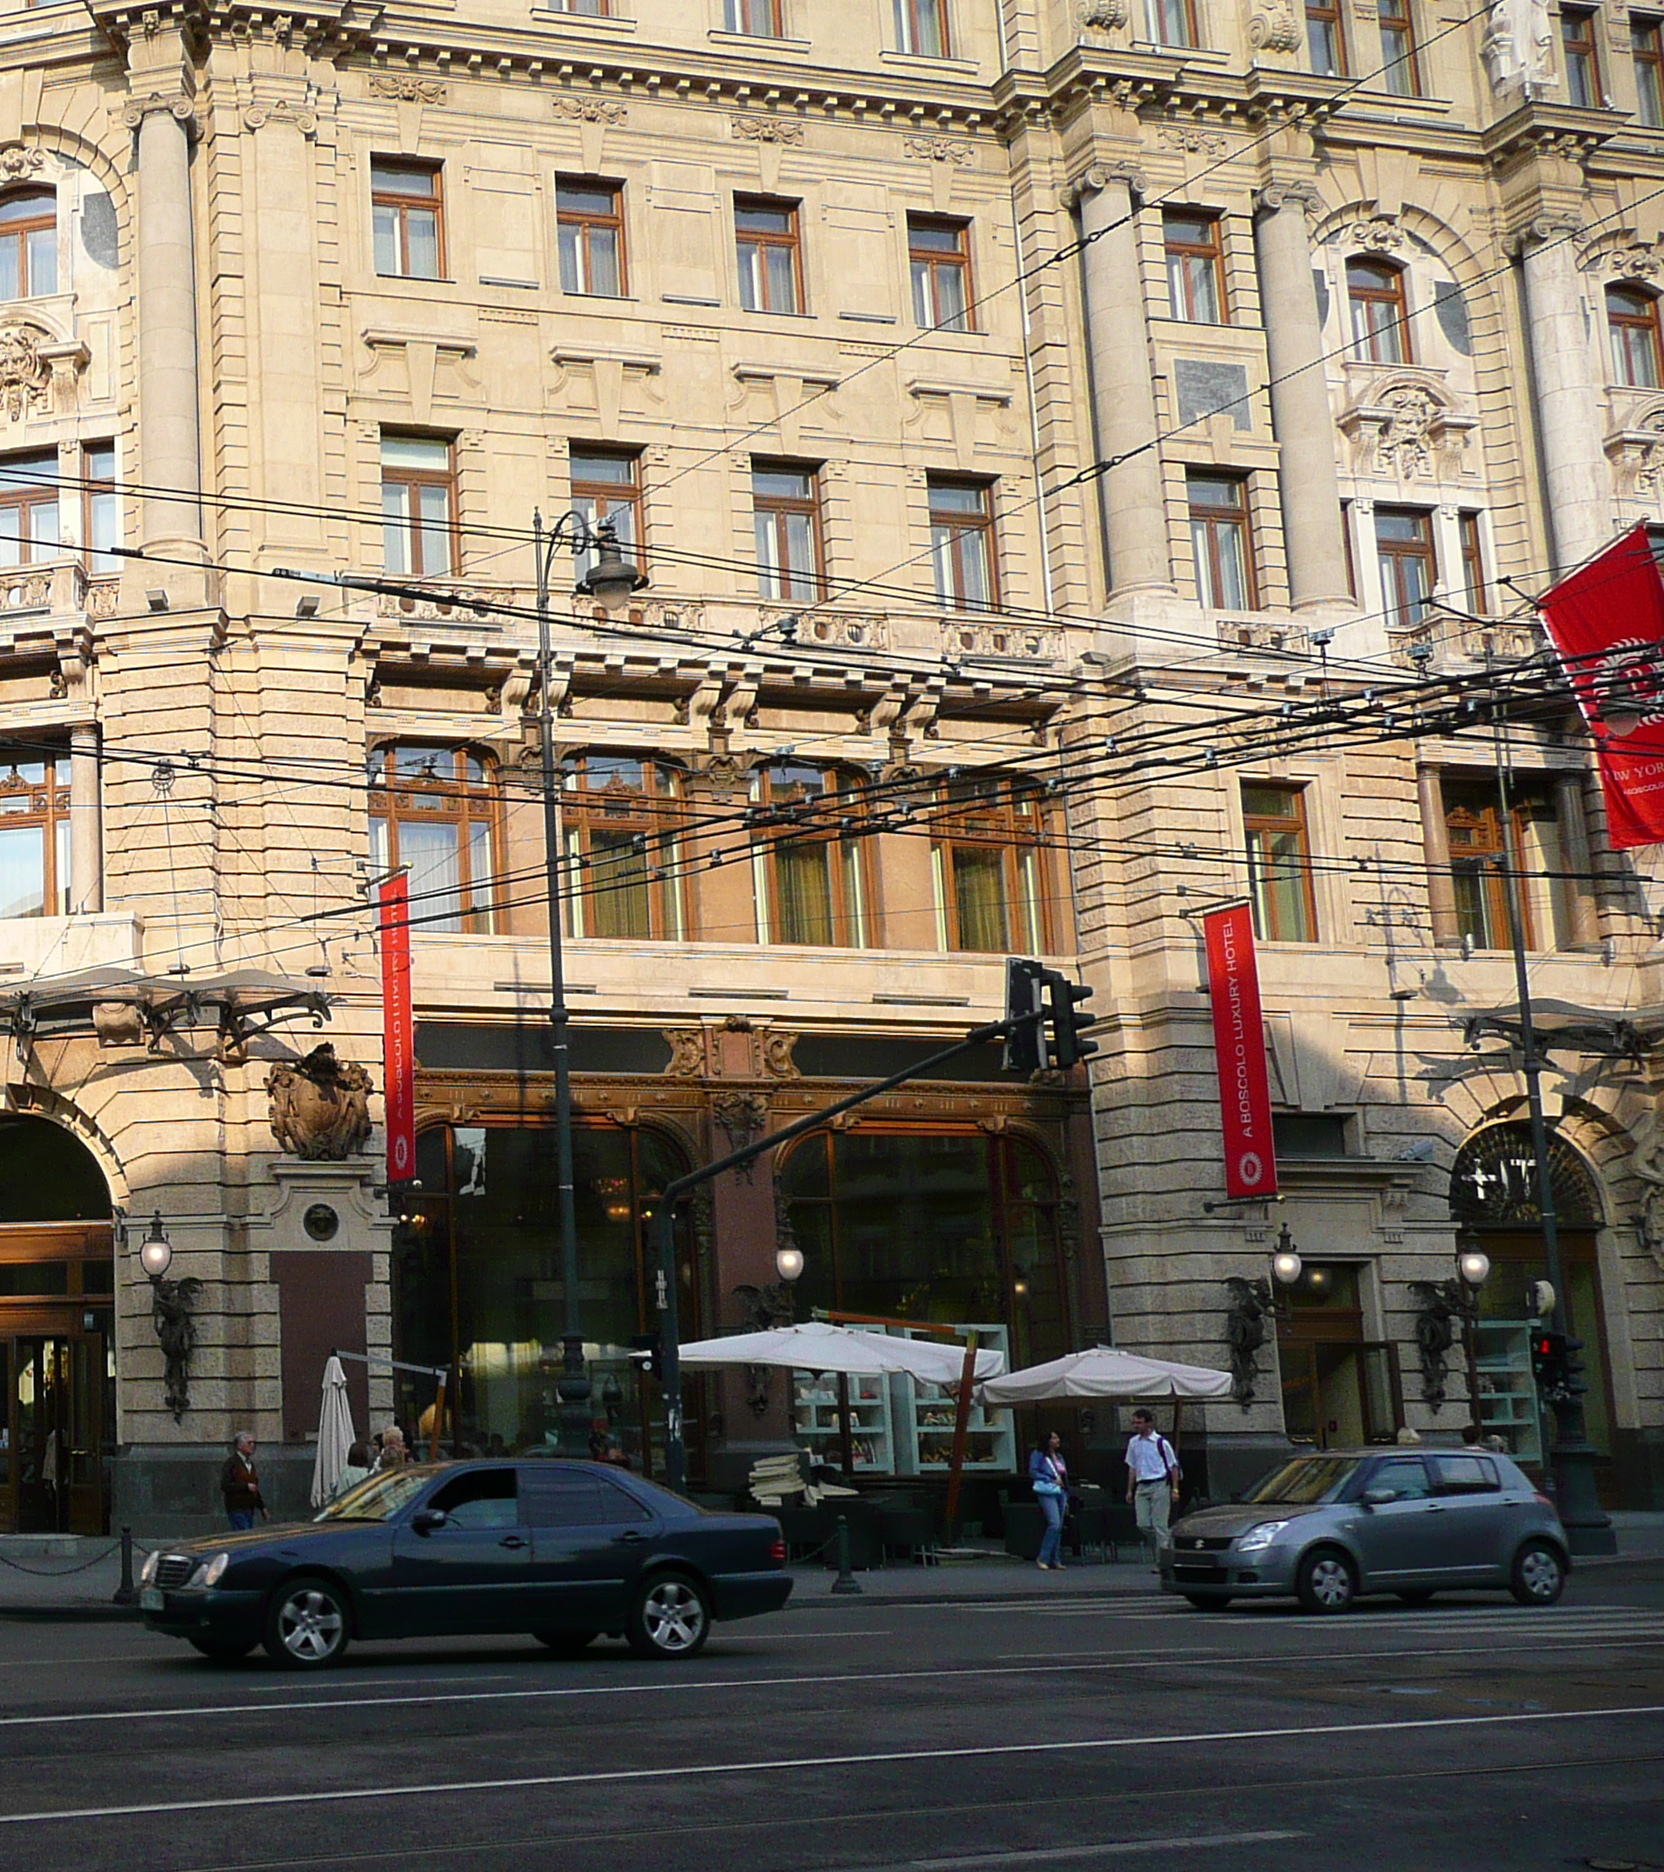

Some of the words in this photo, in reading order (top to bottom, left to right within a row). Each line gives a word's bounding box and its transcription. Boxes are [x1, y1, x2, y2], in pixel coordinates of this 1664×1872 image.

[1604, 769, 1630, 781] NW
[1223, 918, 1237, 972] HOTEL
[1228, 977, 1244, 1040] LUXURY
[1235, 1044, 1252, 1123] BOSCOLO
[1242, 1126, 1253, 1138] A
